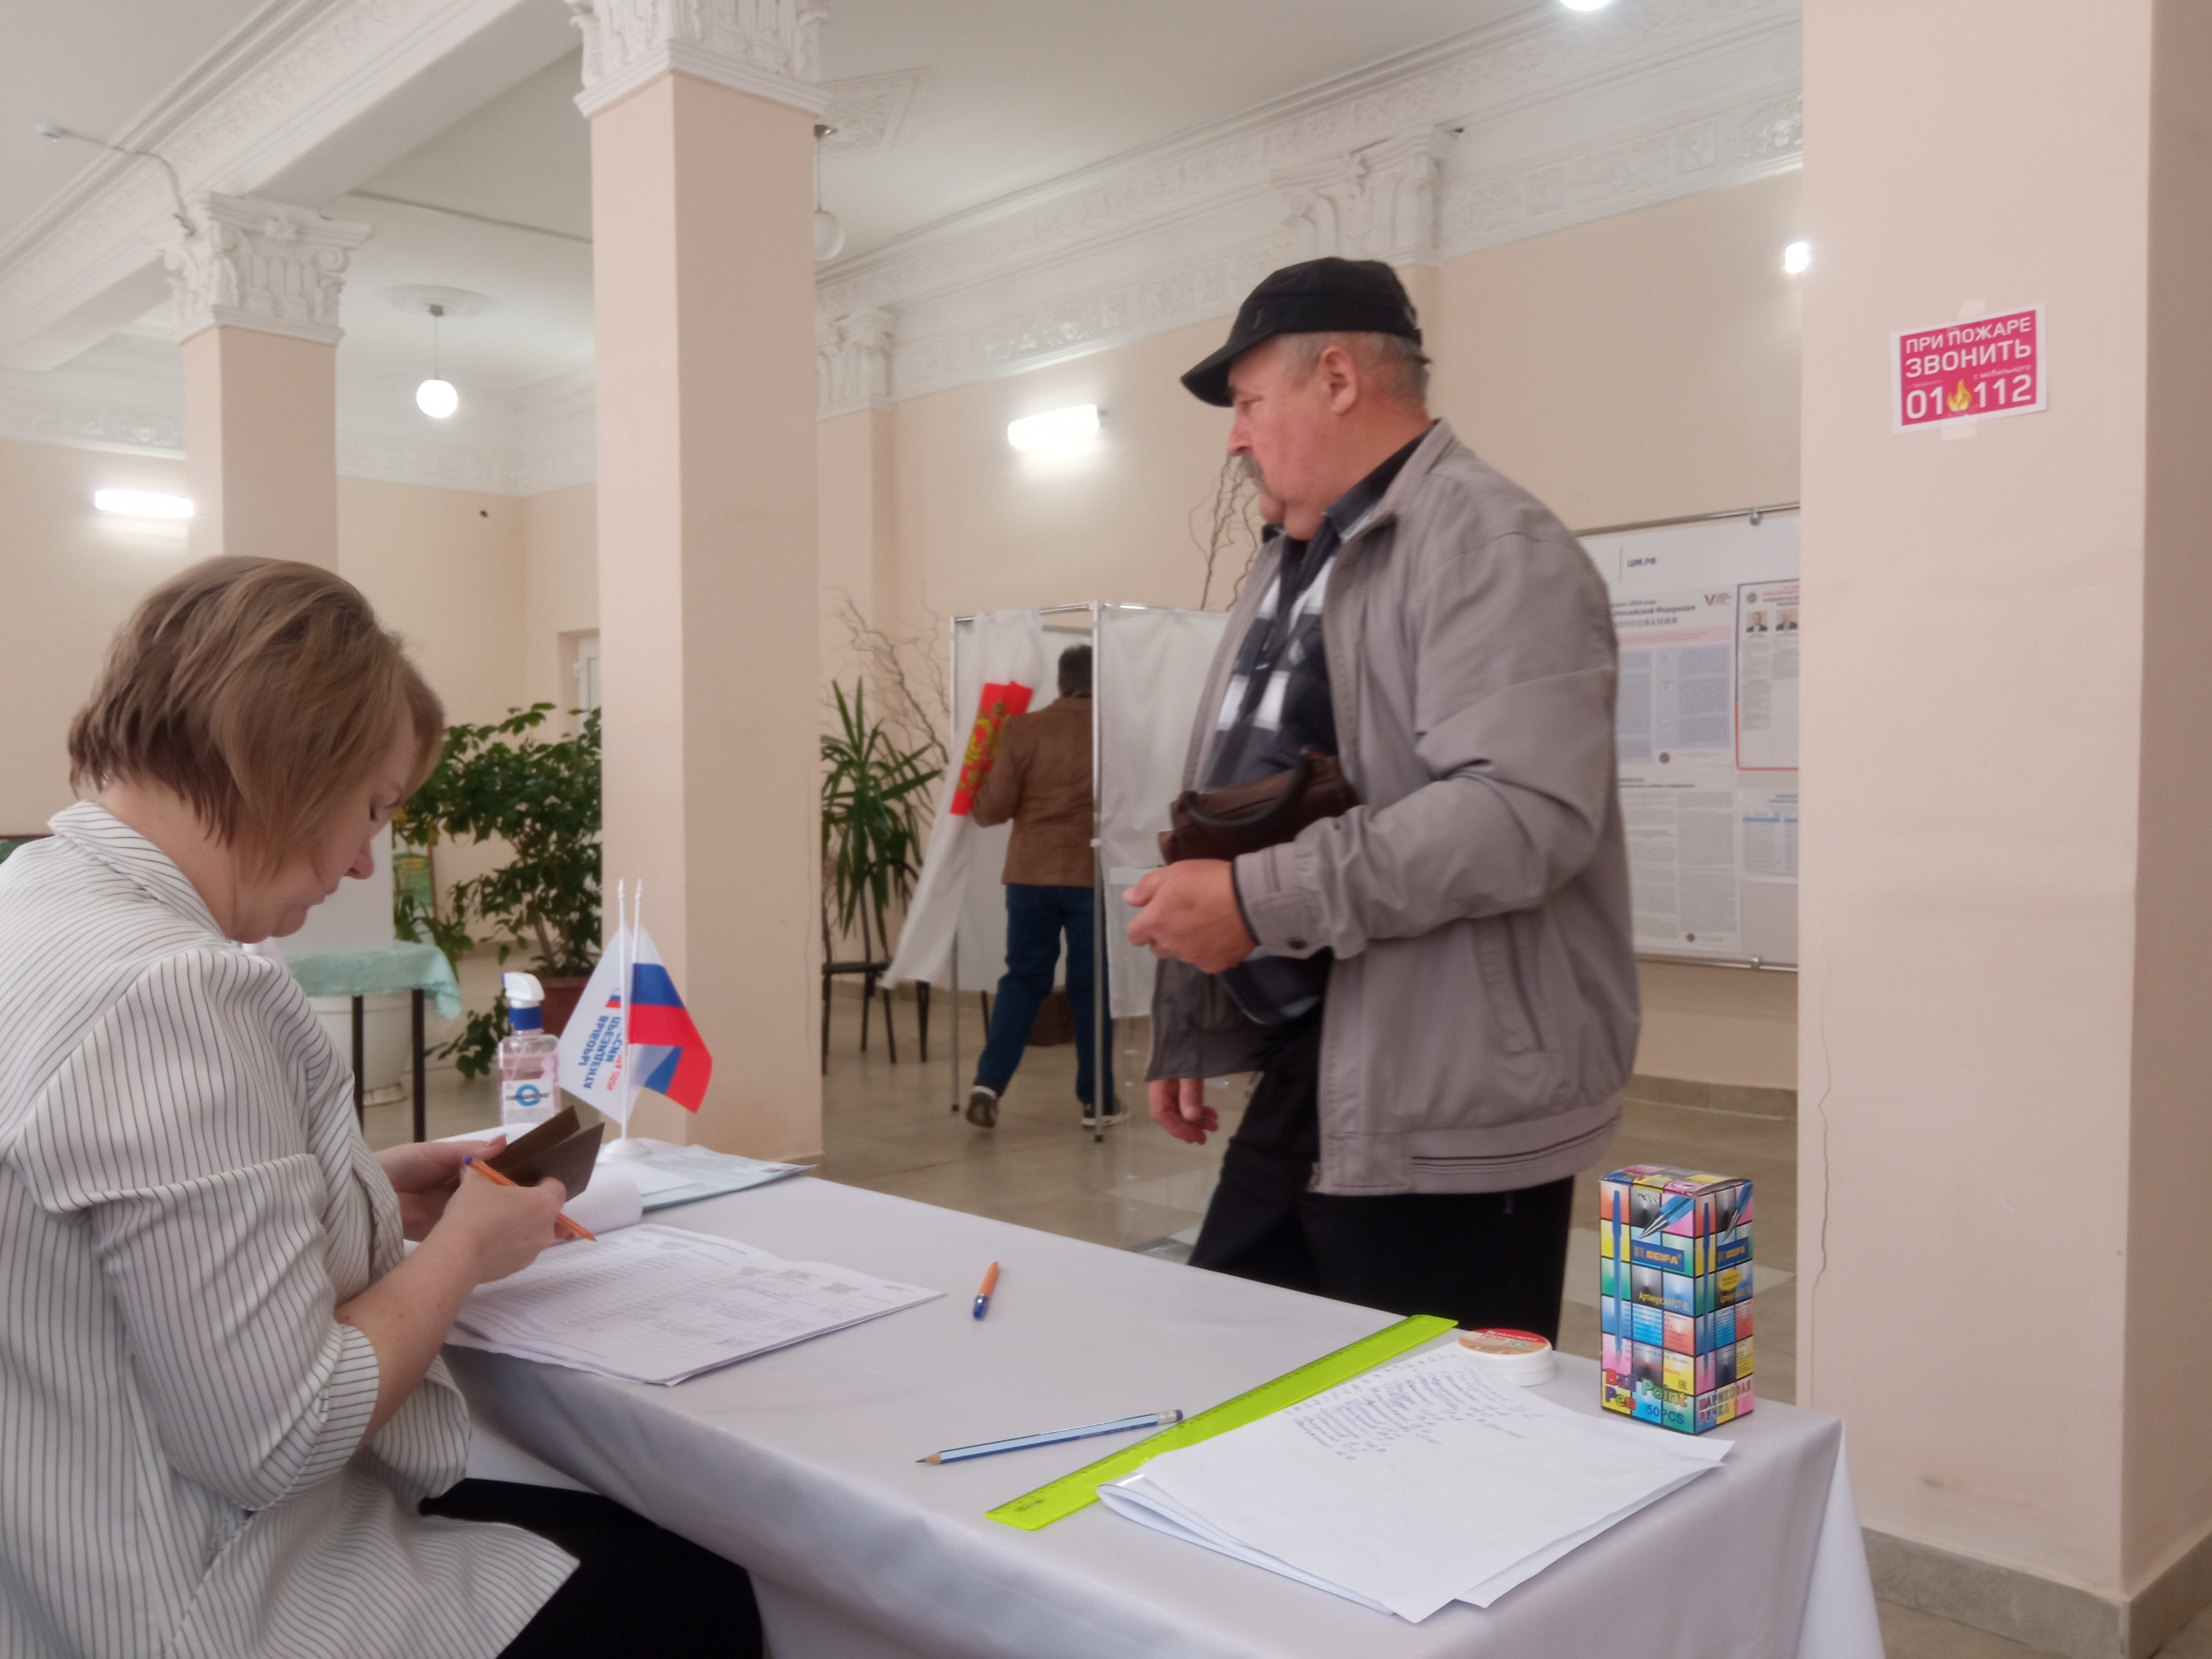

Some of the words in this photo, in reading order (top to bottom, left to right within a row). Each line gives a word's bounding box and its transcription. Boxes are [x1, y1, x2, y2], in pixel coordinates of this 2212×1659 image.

[1906, 334, 1943, 354] ПРИ
[1949, 316, 2031, 346] ПОЖАРЕ
[1905, 339, 2032, 378] ЗВОНИТЬ
[1980, 364, 2032, 379] мобильного
[1906, 386, 1943, 419] 01
[1973, 374, 2032, 408] 112
[1627, 557, 1656, 568] ЦИК.РФ
[1655, 605, 1696, 614] Федерации
[1646, 1250, 1679, 1265] BEIFA
[1606, 1367, 1637, 1393] Ball
[1641, 1377, 1688, 1407] Point
[1606, 1386, 1637, 1411] Pen
